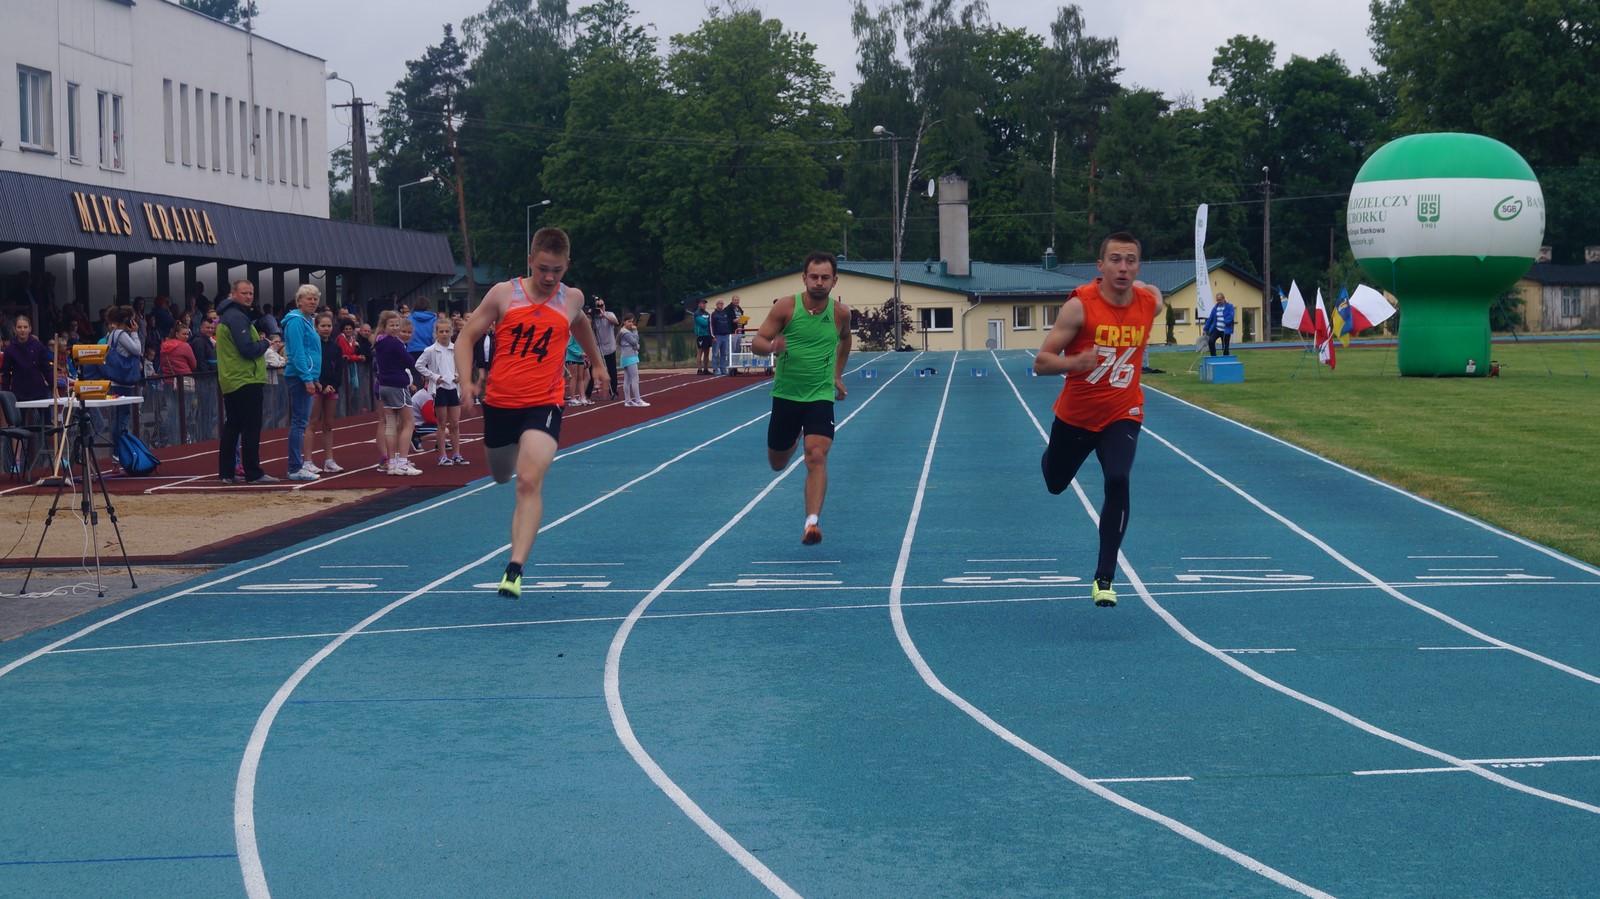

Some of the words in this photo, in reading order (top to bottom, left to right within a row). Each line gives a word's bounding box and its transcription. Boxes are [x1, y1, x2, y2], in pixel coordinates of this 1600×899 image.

[73, 191, 133, 236] MLKS
[1420, 202, 1437, 215] BS
[1502, 205, 1517, 213] SGB
[509, 322, 553, 363] 114
[1094, 324, 1145, 347] CREW
[1085, 344, 1137, 388] 76
